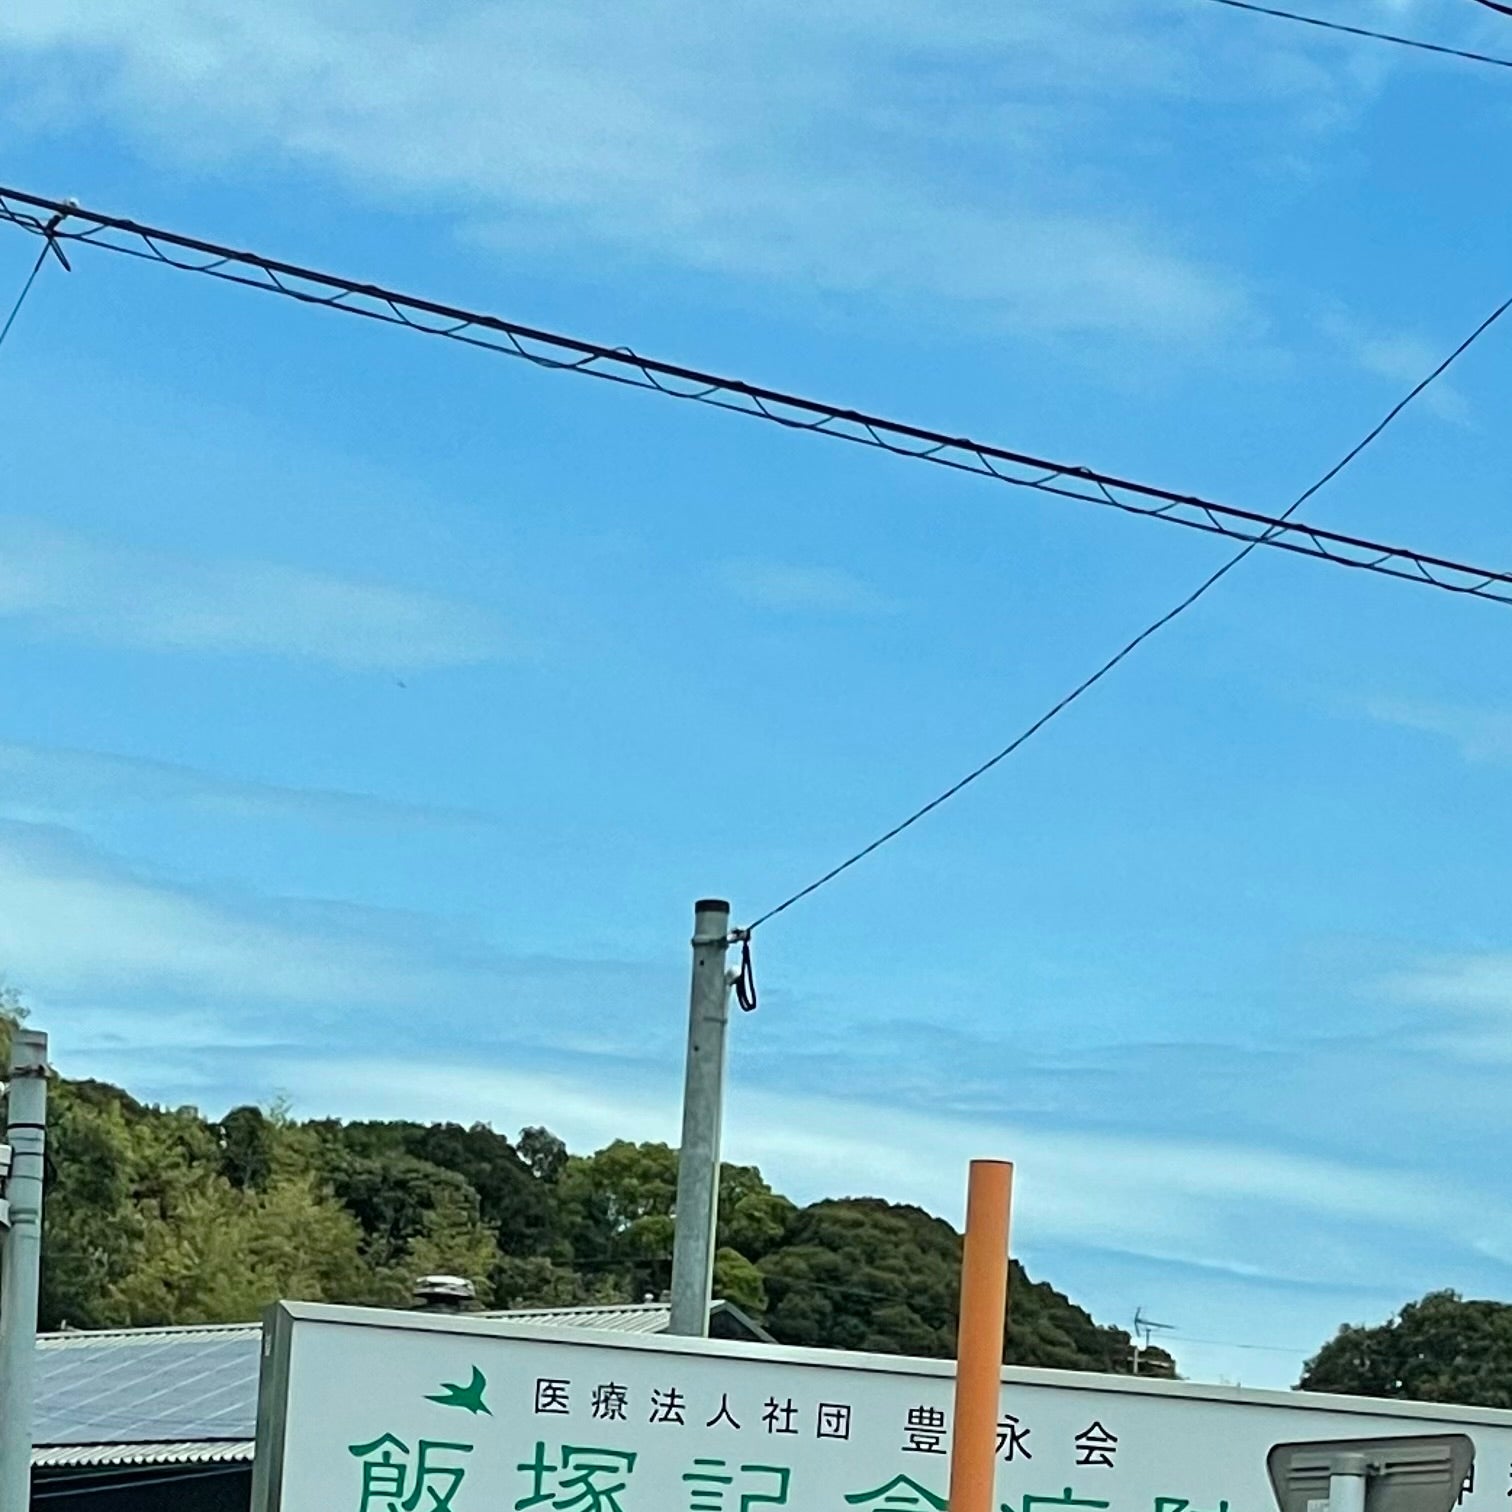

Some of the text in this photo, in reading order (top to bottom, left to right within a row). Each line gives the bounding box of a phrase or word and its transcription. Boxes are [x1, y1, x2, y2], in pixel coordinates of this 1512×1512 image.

[534, 1377, 1118, 1469] 医療法人社団 豊永会
